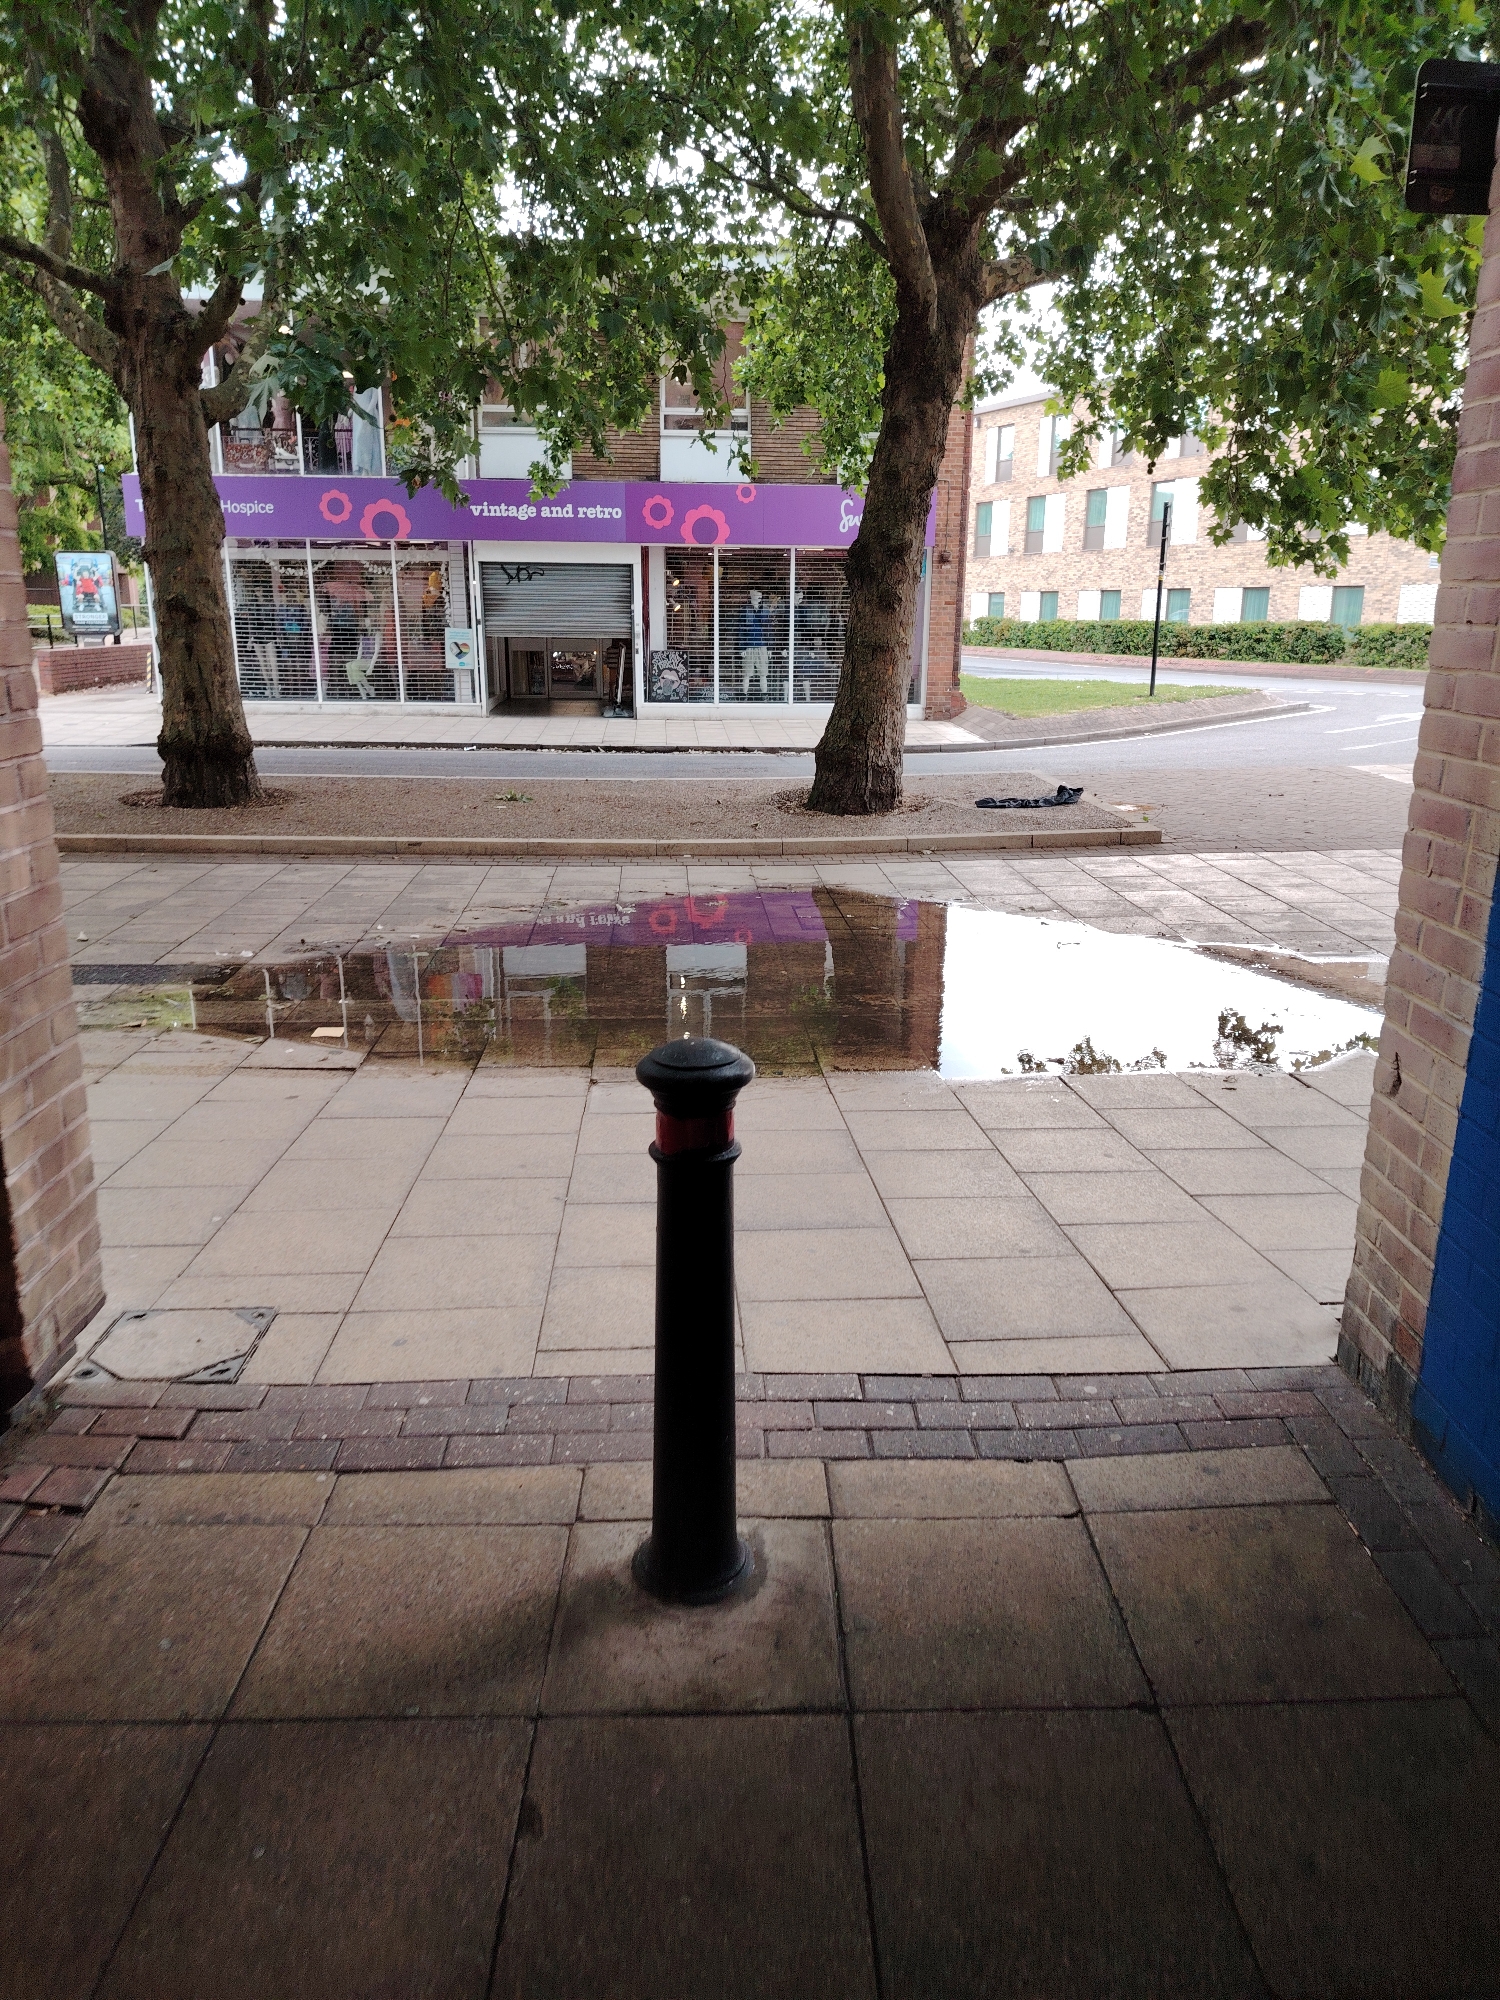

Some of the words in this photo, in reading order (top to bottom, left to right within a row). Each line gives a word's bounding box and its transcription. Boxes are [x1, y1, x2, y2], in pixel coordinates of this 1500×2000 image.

[220, 500, 275, 516] Hospice
[470, 501, 537, 520] vintage
[540, 503, 574, 518] and
[577, 504, 623, 519] retro
